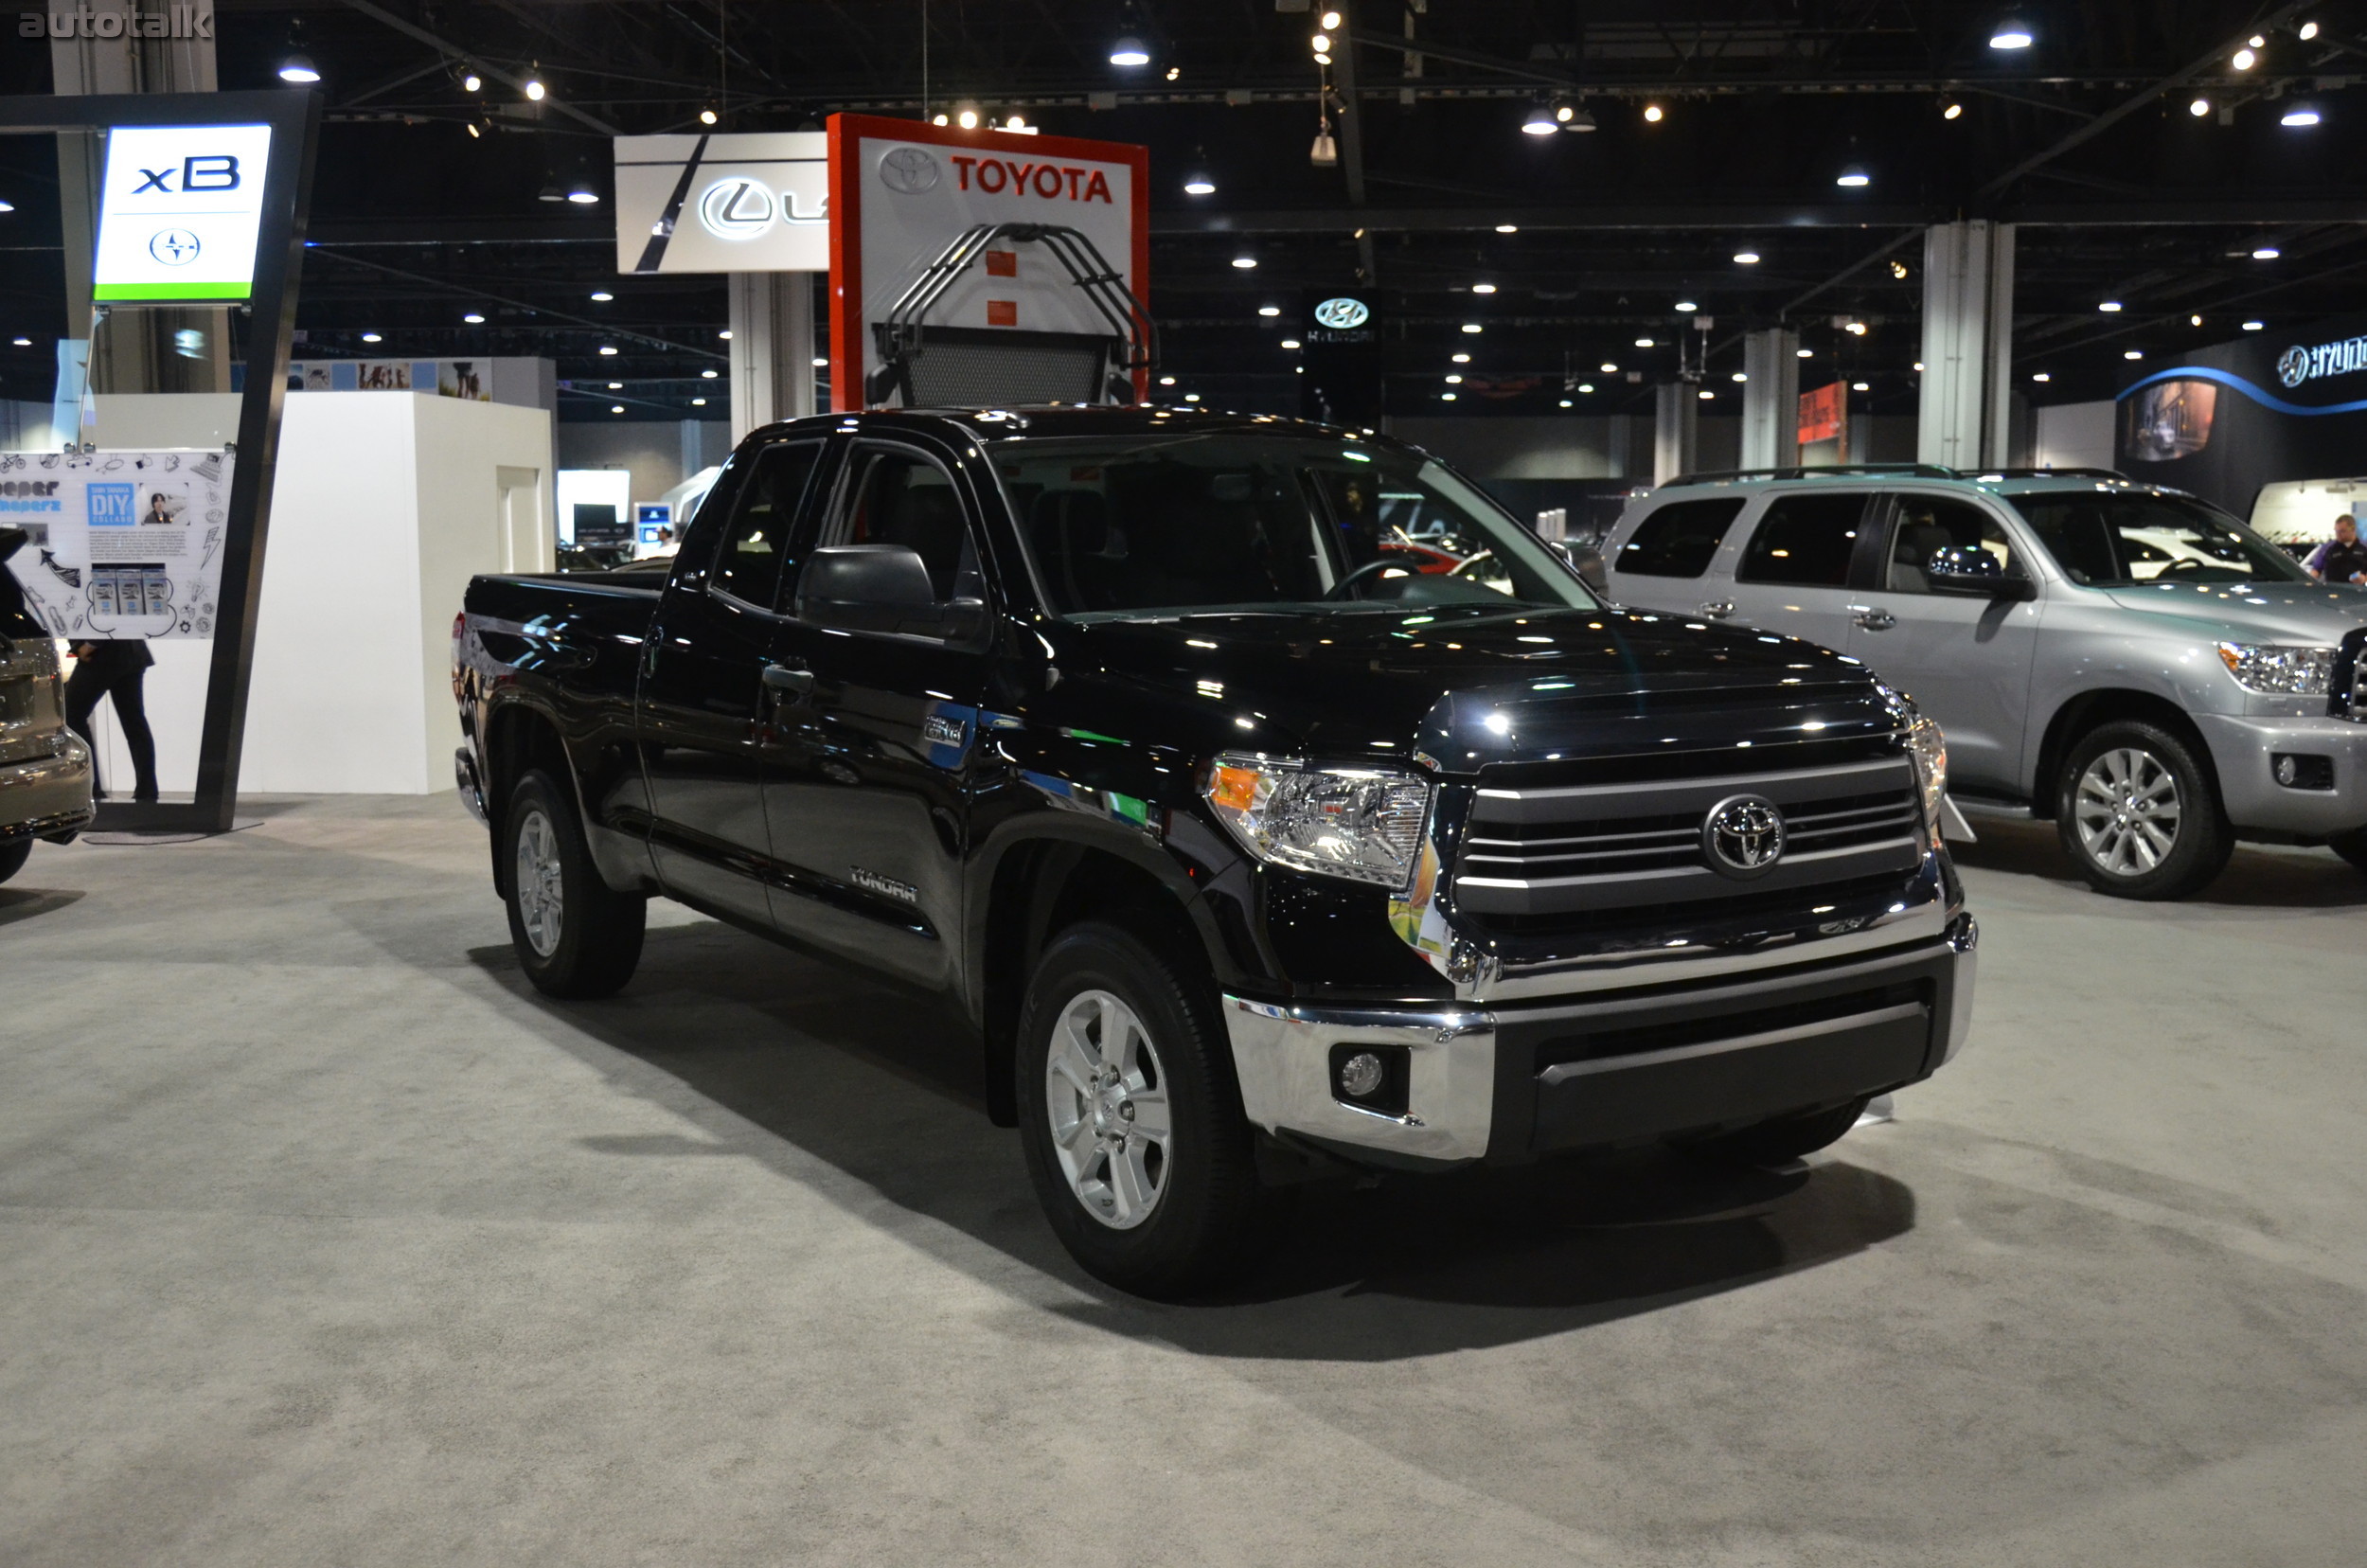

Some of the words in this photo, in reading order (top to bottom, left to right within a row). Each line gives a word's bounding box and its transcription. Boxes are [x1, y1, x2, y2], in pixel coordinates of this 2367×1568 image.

[131, 155, 241, 194] xB
[951, 156, 1112, 204] TOYOTA
[92, 494, 130, 516] DIY
[849, 864, 919, 902] TUNDRA
